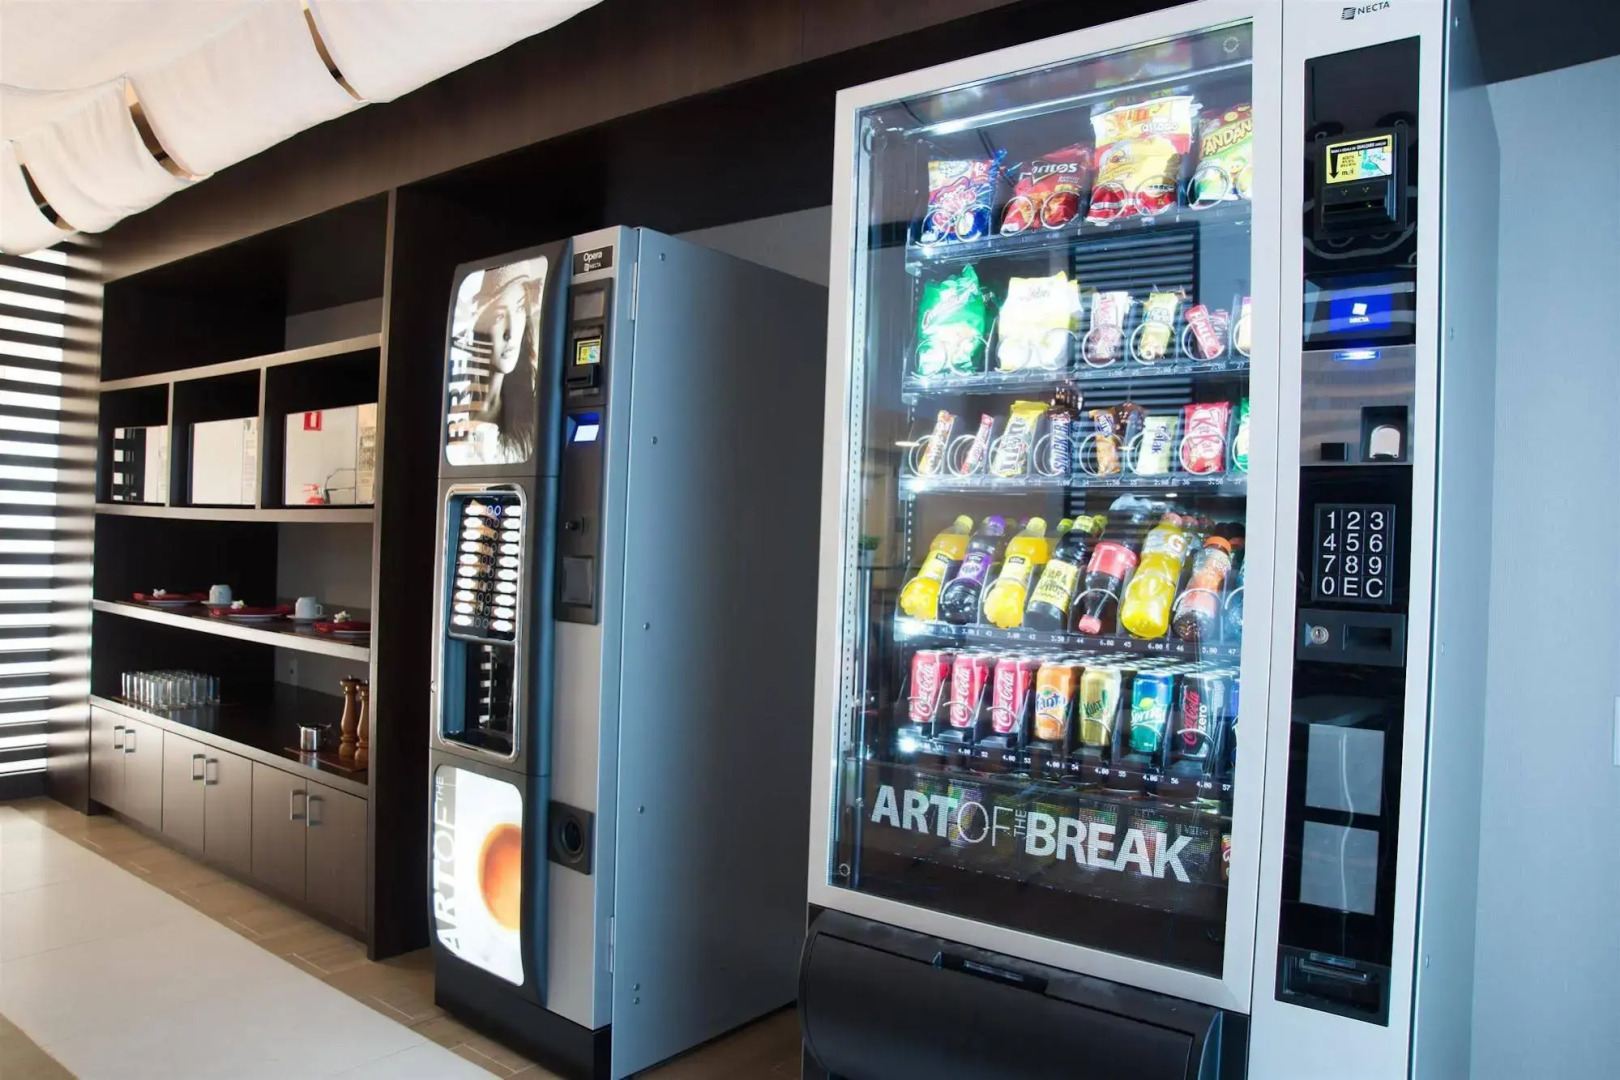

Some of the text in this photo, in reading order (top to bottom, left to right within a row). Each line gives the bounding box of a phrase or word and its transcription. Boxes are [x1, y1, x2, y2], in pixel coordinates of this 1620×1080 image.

[1357, 1, 1391, 15] NECTA
[1199, 119, 1252, 157] ANDAN
[1031, 162, 1078, 175] oritos
[583, 251, 603, 263] Opera
[1189, 312, 1217, 347] HALLS
[1326, 511, 1384, 531] 1 2 3
[1323, 532, 1383, 553] 4 5 6
[1322, 554, 1382, 575] 7 8 9
[1321, 576, 1383, 598] 0 E C
[1147, 642, 1163, 651] 6.00
[1176, 644, 1185, 652] 46
[1228, 648, 1237, 656] 47
[1198, 703, 1208, 732] zero
[957, 747, 971, 756] 4.00
[1002, 753, 1016, 762] 4.00
[1023, 756, 1031, 764] 53
[1046, 760, 1060, 768] 4.00
[1071, 763, 1079, 771] 54
[1094, 767, 1109, 776] 4.00
[1118, 770, 1127, 778] 55
[1142, 774, 1158, 782] 4.00
[1171, 777, 1179, 785] 56
[1196, 781, 1212, 789] 4.00
[1222, 783, 1231, 791] 57
[870, 784, 1192, 884] ART OF THE BREAK
